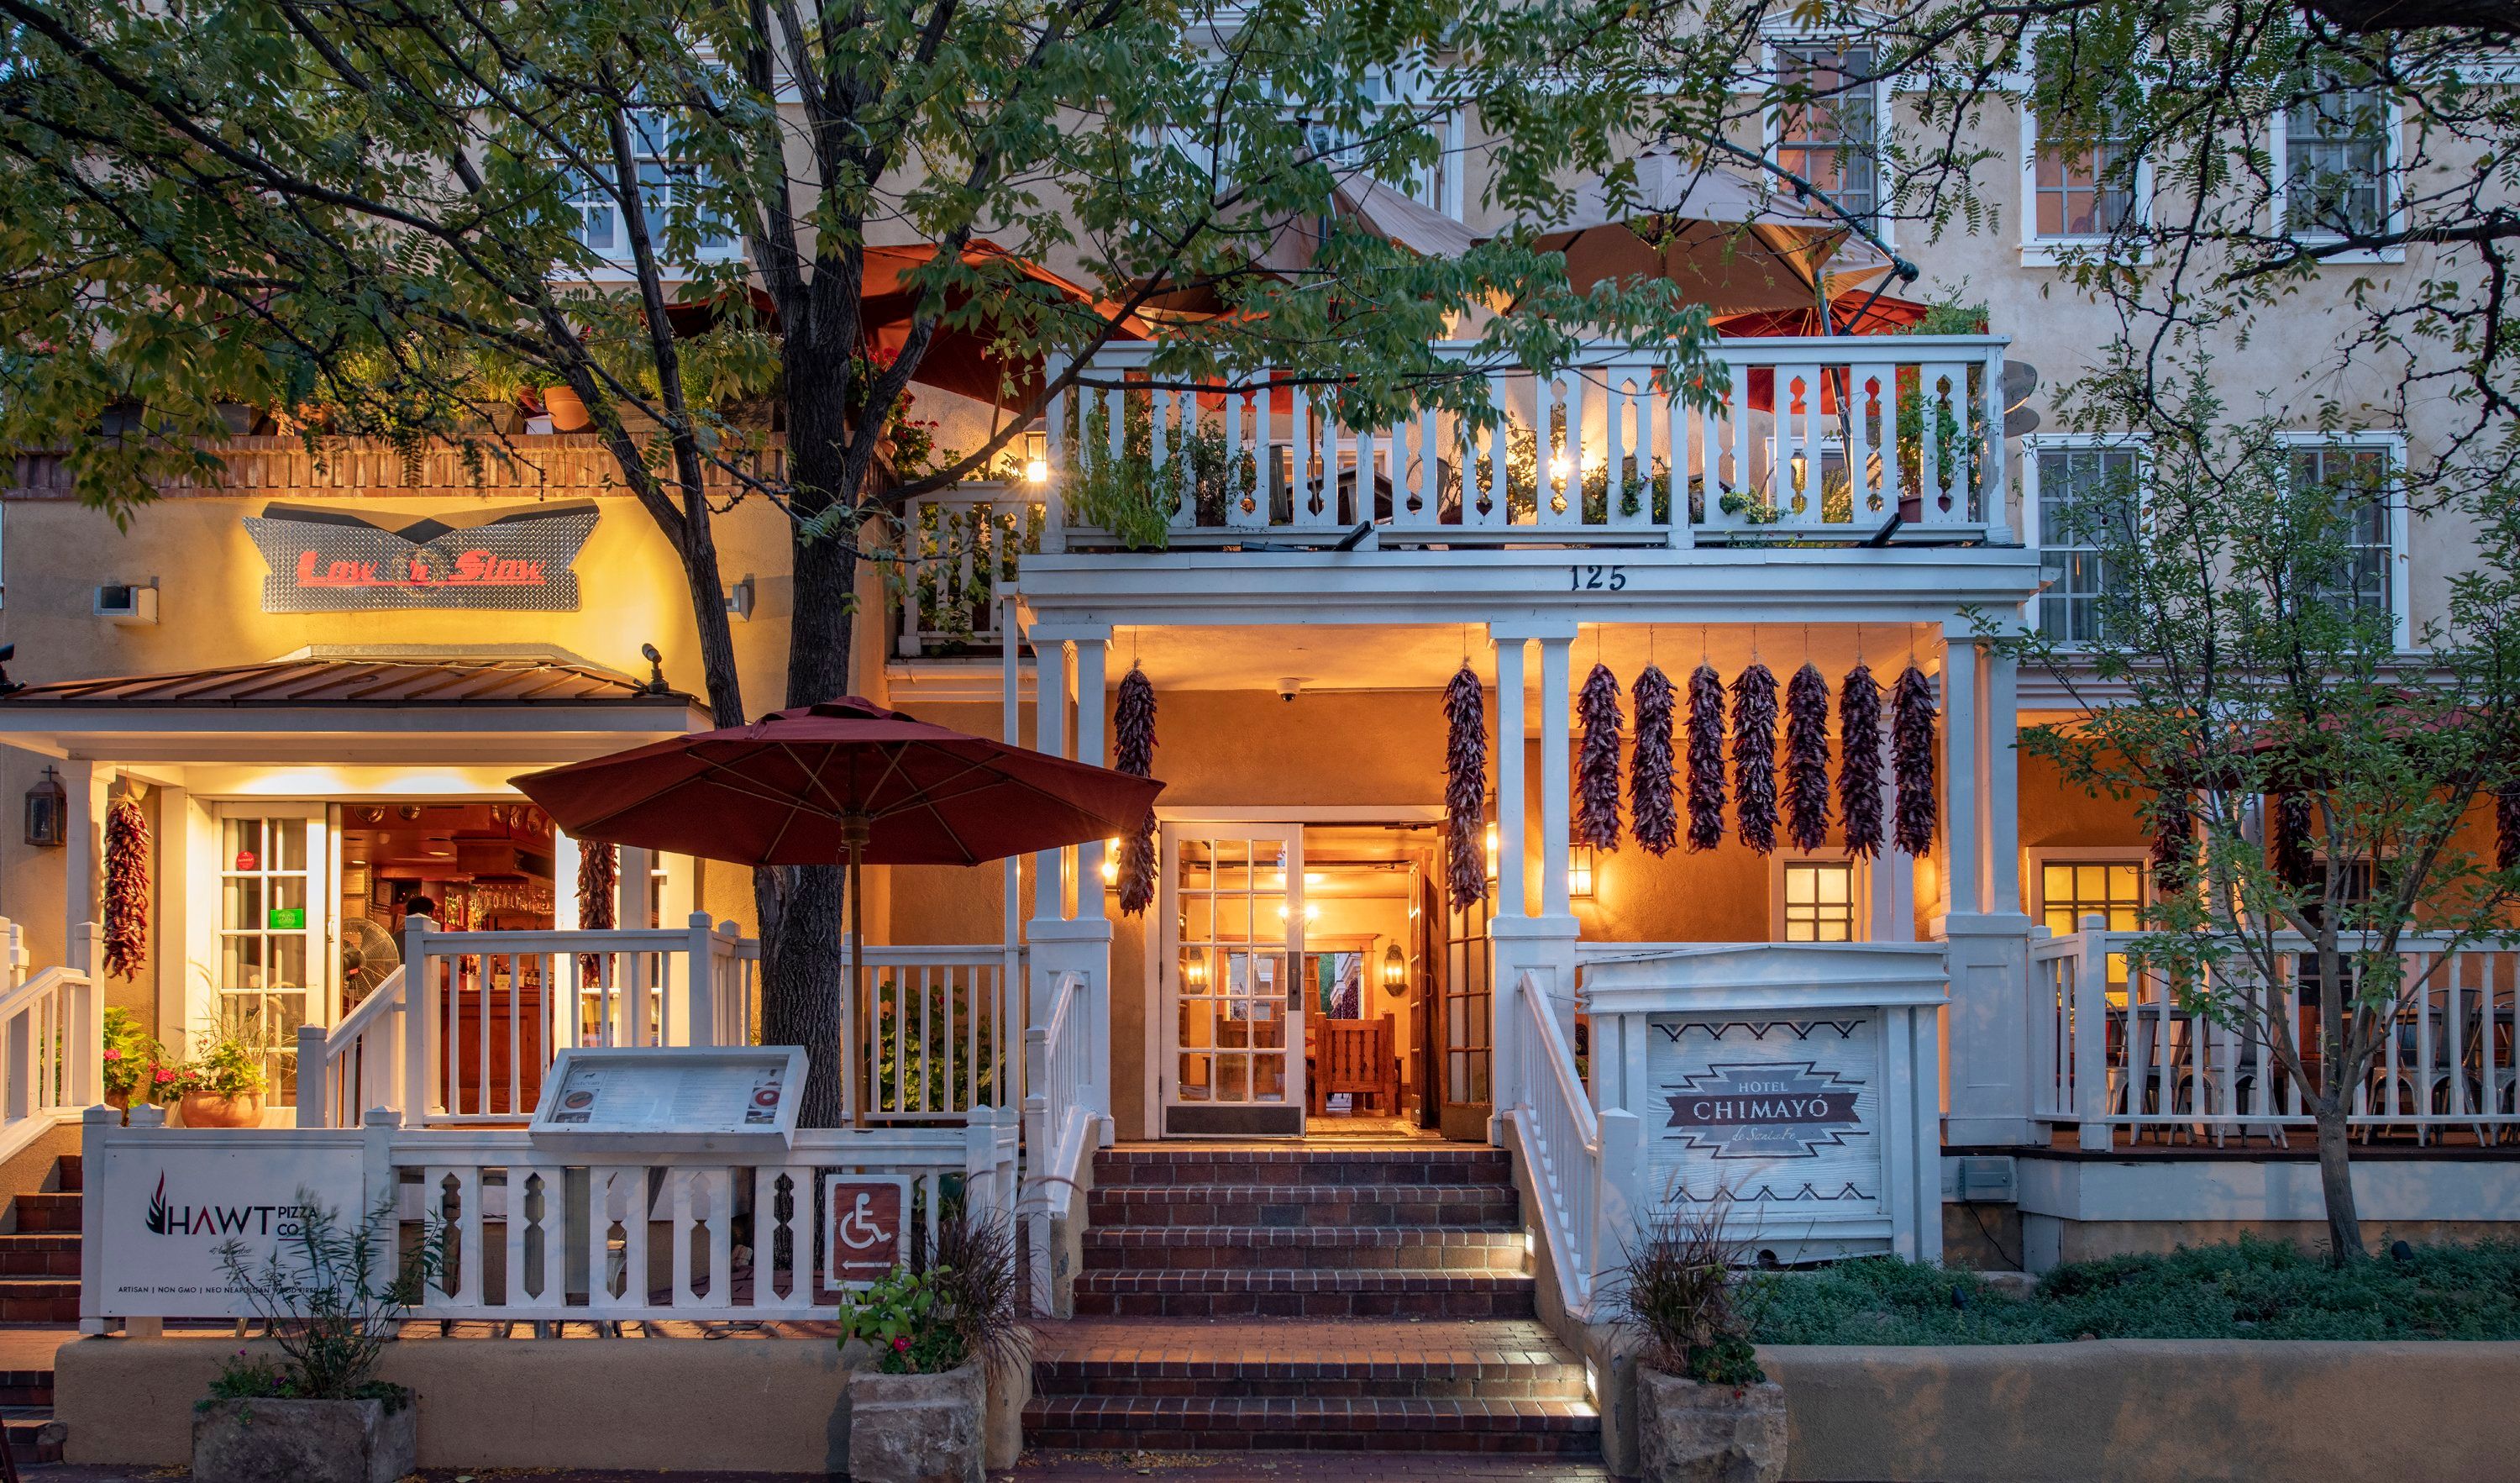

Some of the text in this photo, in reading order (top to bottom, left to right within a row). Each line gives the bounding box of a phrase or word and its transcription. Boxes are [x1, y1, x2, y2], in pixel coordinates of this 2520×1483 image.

[297, 550, 379, 581] Low
[449, 550, 548, 581] Slow
[1569, 565, 1626, 592] 125
[1739, 1081, 1788, 1092] HOTEL
[1693, 1094, 1829, 1121] CHIMAYÓ
[1732, 1125, 1744, 1141] de
[1782, 1128, 1797, 1140] Fe
[169, 1206, 276, 1235] HAWT
[278, 1206, 318, 1218] PIZZA
